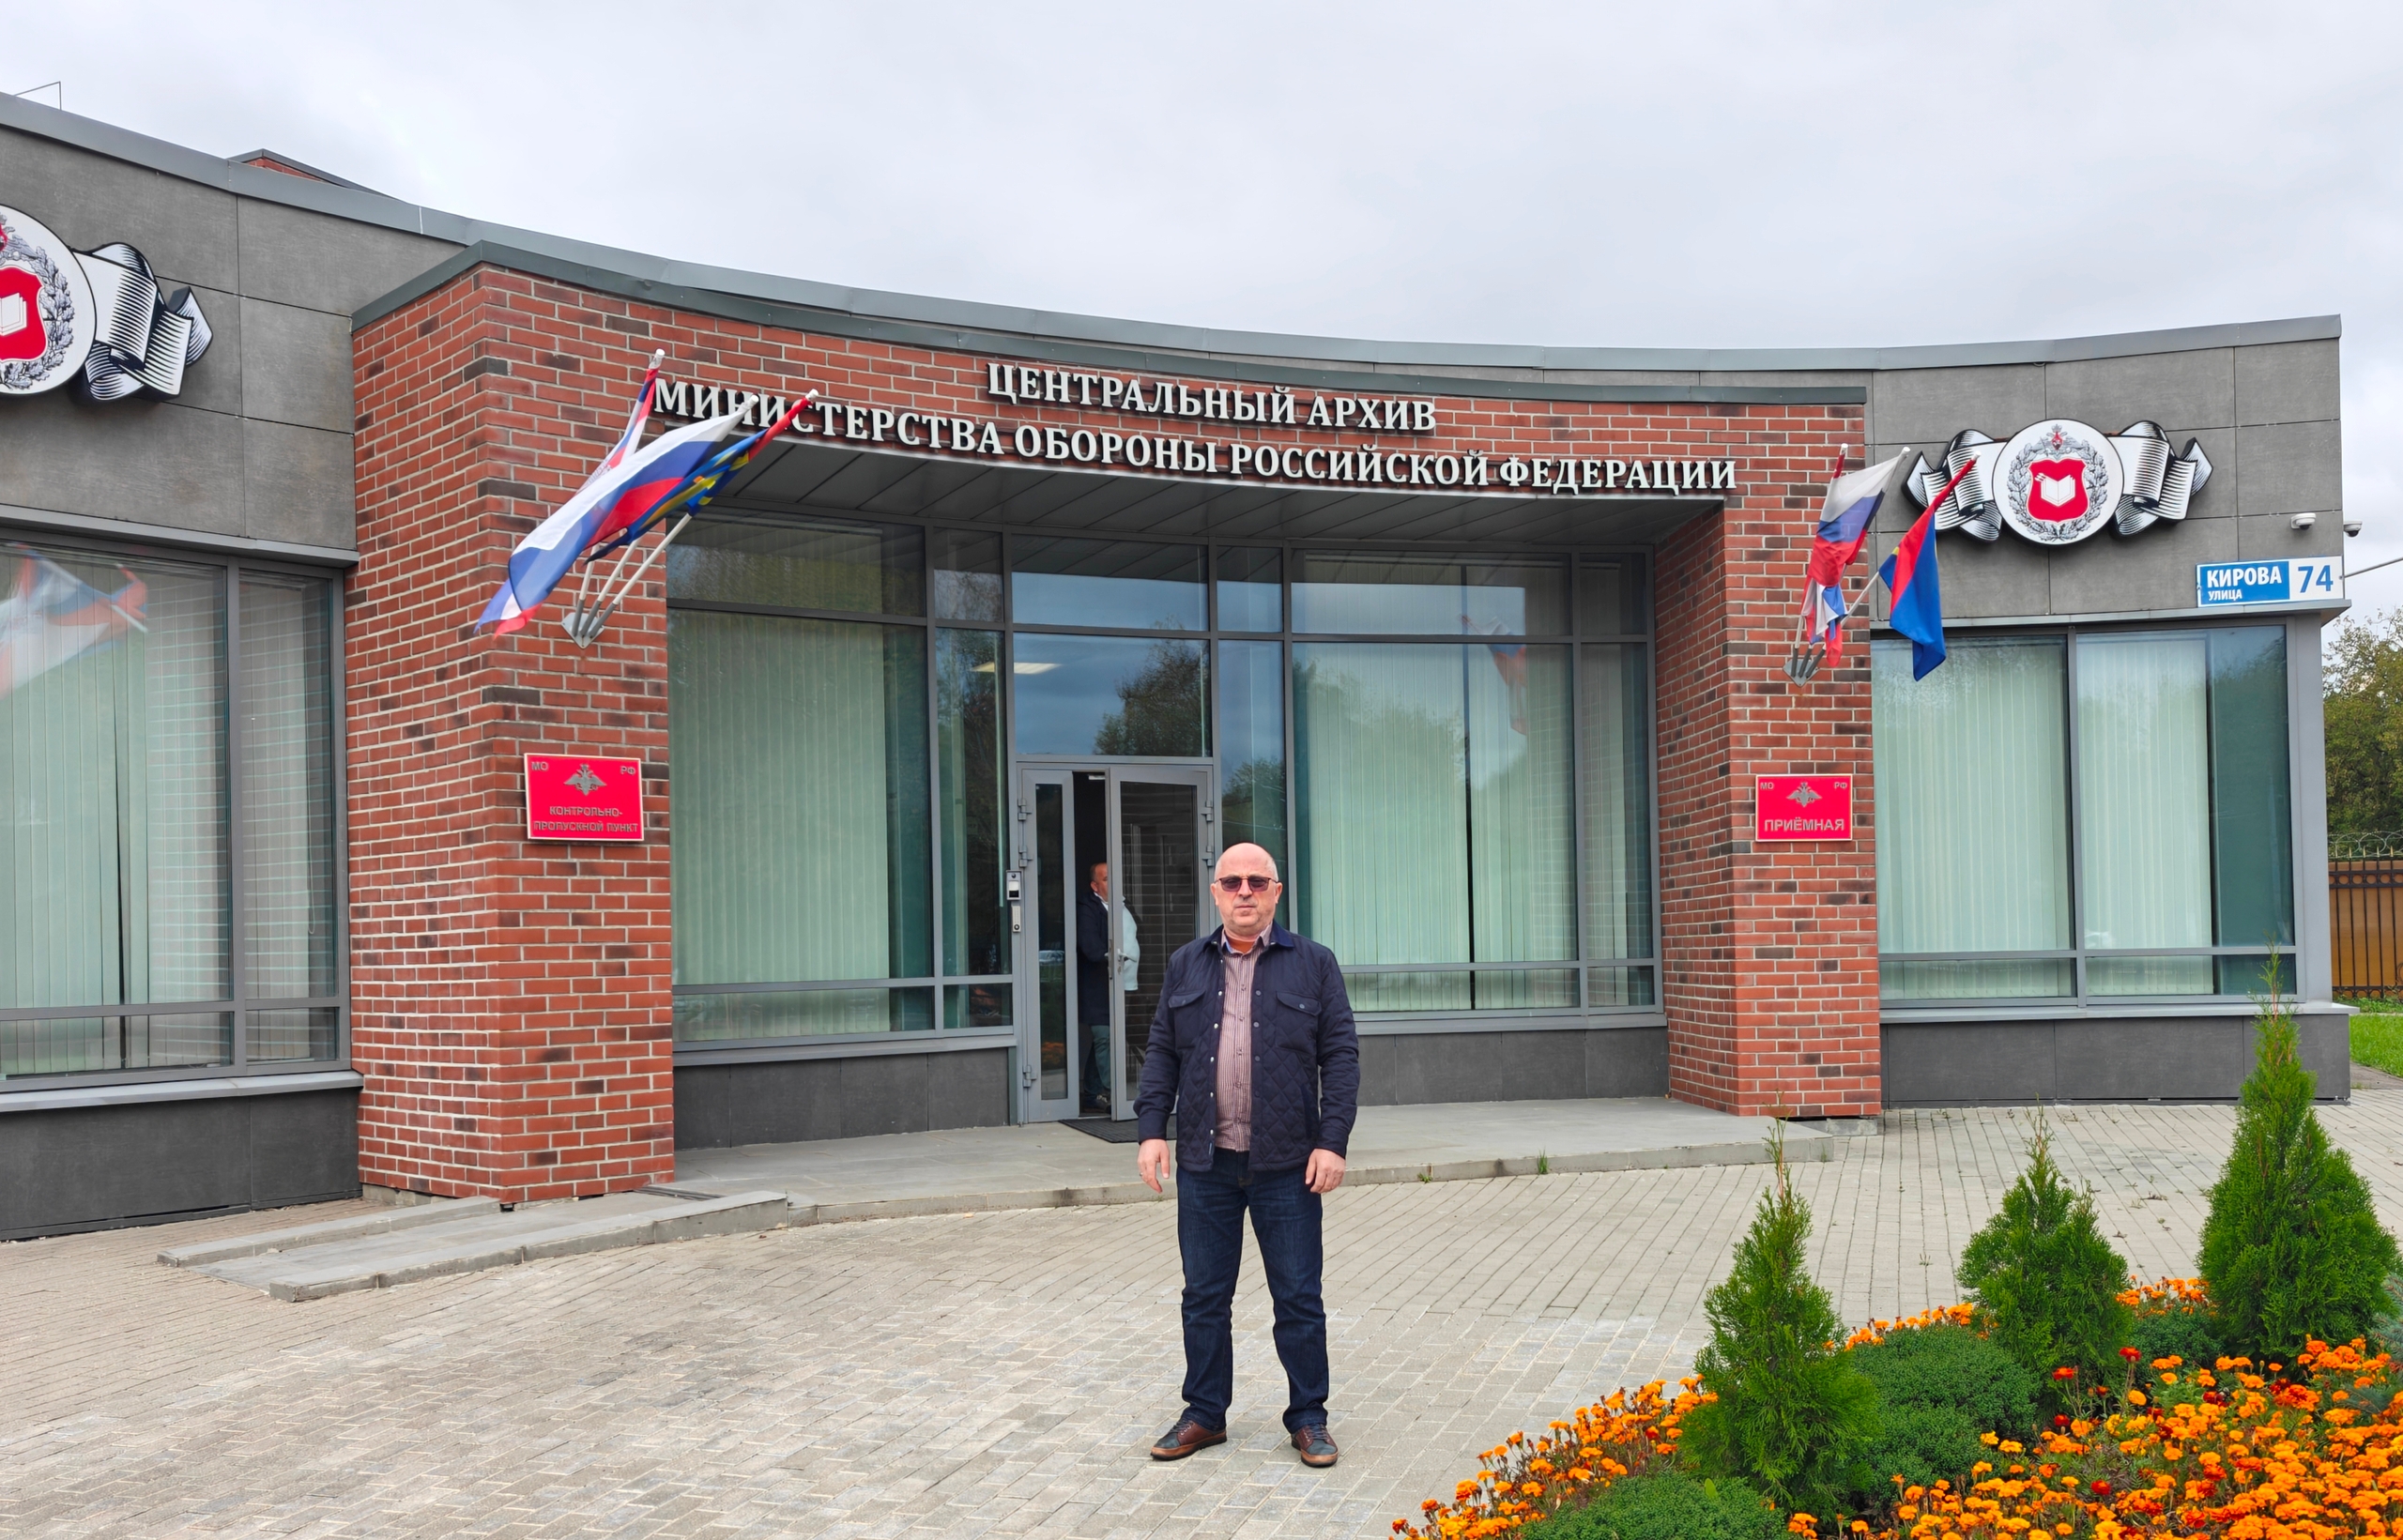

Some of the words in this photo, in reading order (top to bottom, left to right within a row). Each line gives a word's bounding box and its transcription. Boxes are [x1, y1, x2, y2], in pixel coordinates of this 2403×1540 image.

[987, 362, 1296, 424] ЦЕНТРАЛЬНЫЙ
[1307, 395, 1437, 432] АРХИВ
[652, 377, 1005, 455] МИНИСТЕРСТВА
[1014, 425, 1218, 473] ОБОРОНЫ
[1230, 444, 1489, 487] РОССИЙСКОЙ
[1498, 455, 1737, 496] ФЕДЕРАЦИИ
[2207, 565, 2283, 588] КИРОВА
[2297, 564, 2334, 593] 74
[2208, 588, 2243, 602] УЛИЦА
[530, 761, 549, 771] МО
[620, 765, 636, 775] РФ
[1760, 782, 1774, 790] МО
[1833, 782, 1848, 790] РФ
[549, 805, 623, 817] КОНТРОЛЬНО-
[533, 820, 604, 832] ПРОПУСКНОЙ
[606, 823, 638, 832] ПУНКТ
[1764, 816, 1844, 832] ПРИЁМНАЯ
